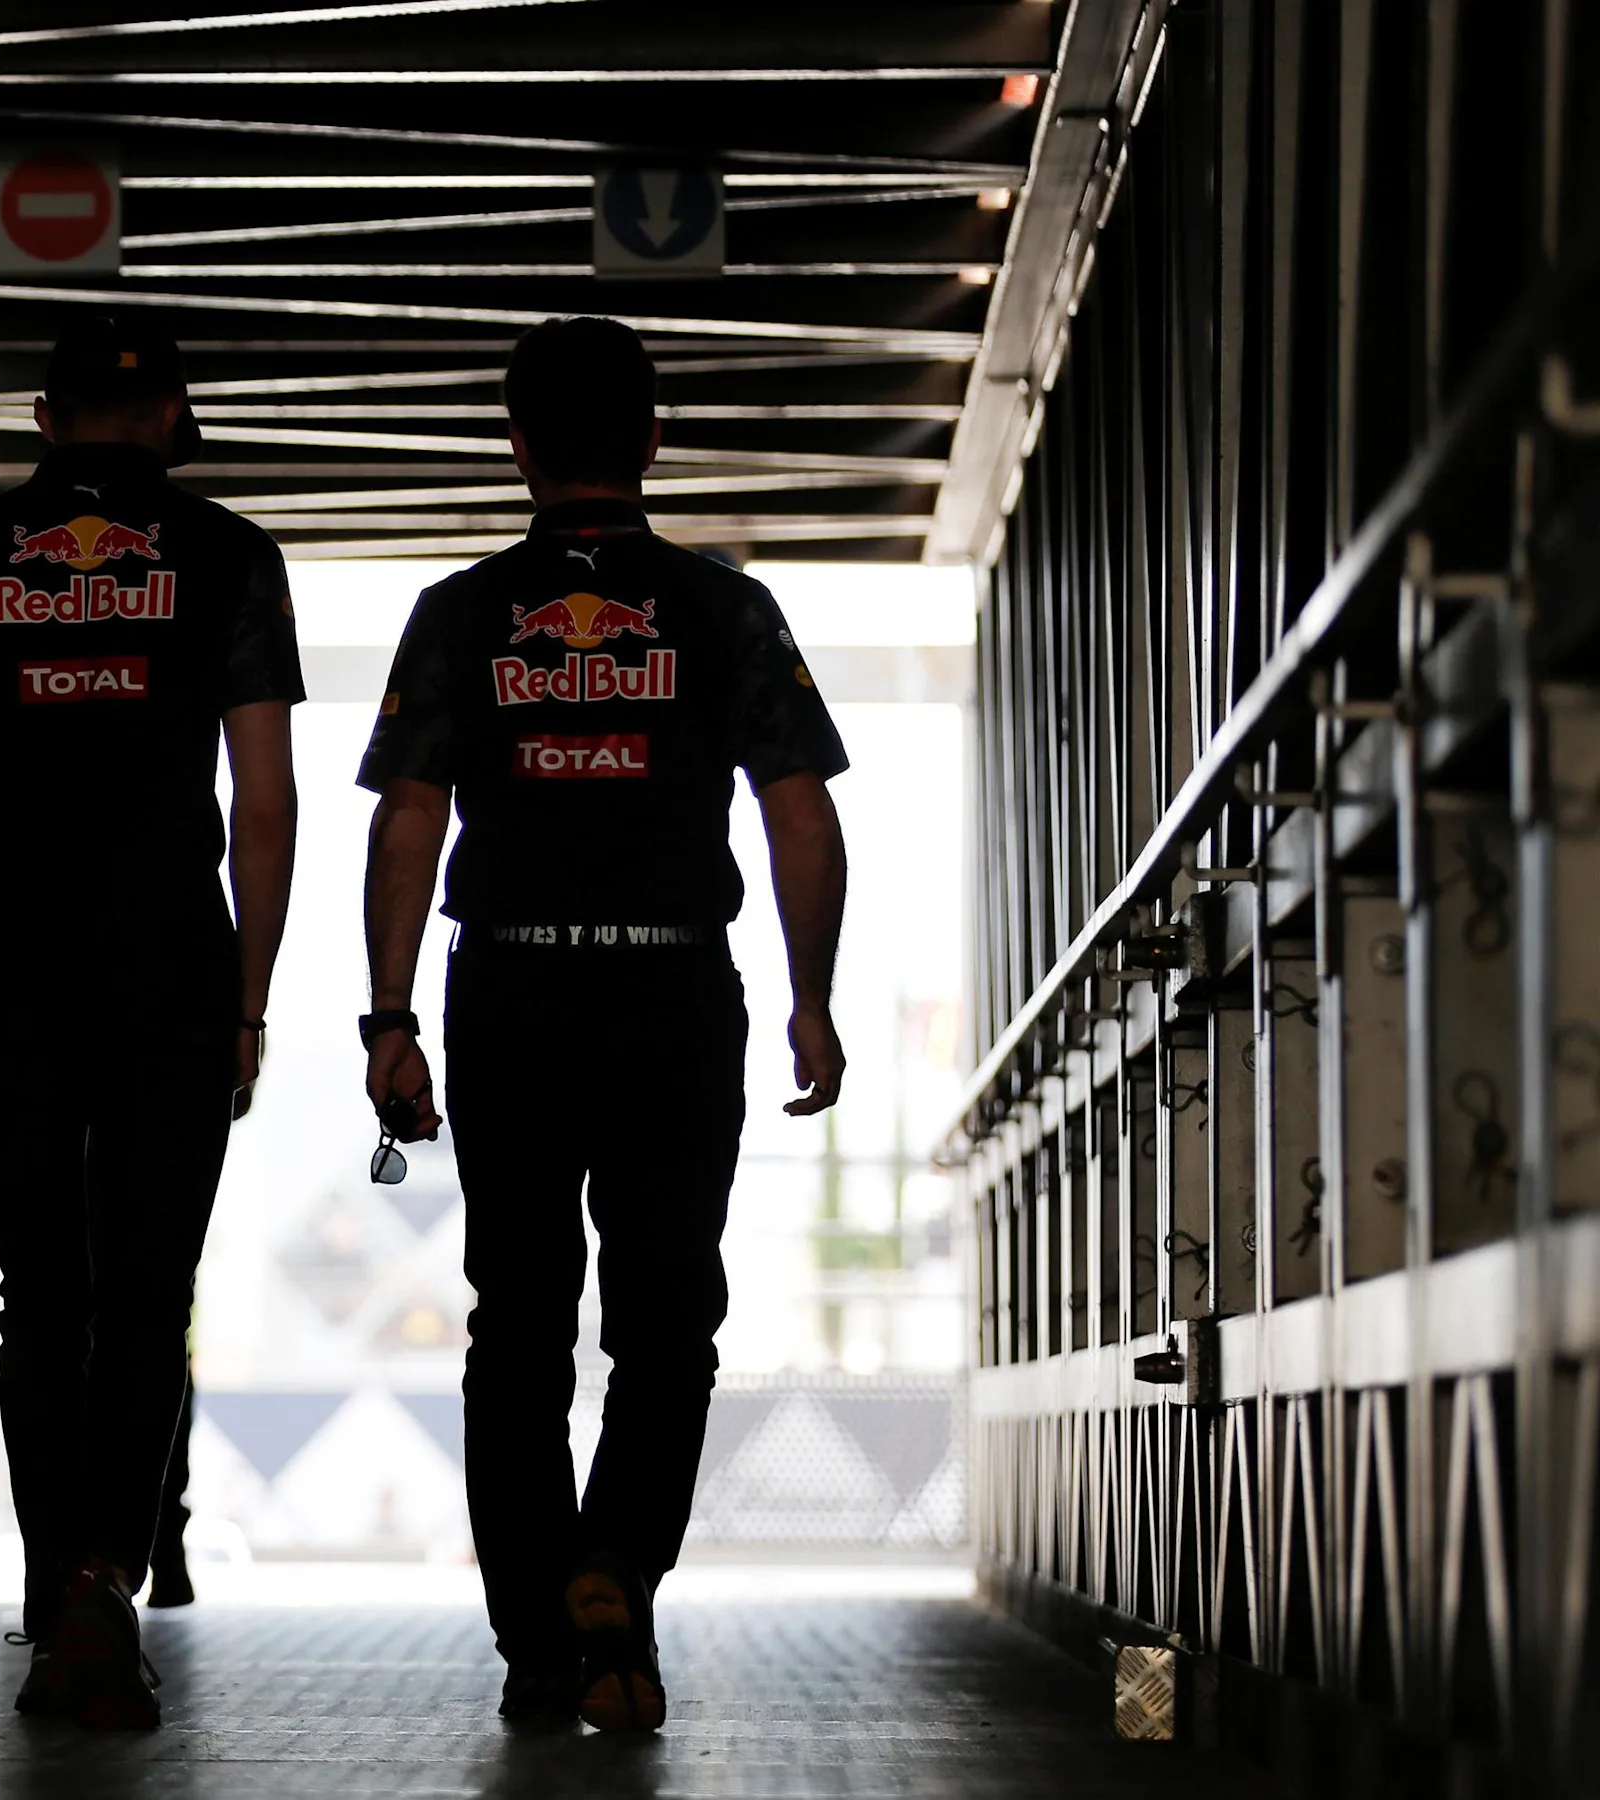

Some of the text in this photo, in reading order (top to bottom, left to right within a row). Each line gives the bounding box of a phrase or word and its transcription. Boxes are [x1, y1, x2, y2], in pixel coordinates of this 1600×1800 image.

[87, 570, 177, 621] Bull
[23, 667, 144, 695] TOTAL
[492, 649, 676, 706] Red Bull
[517, 742, 645, 771] TOTAL
